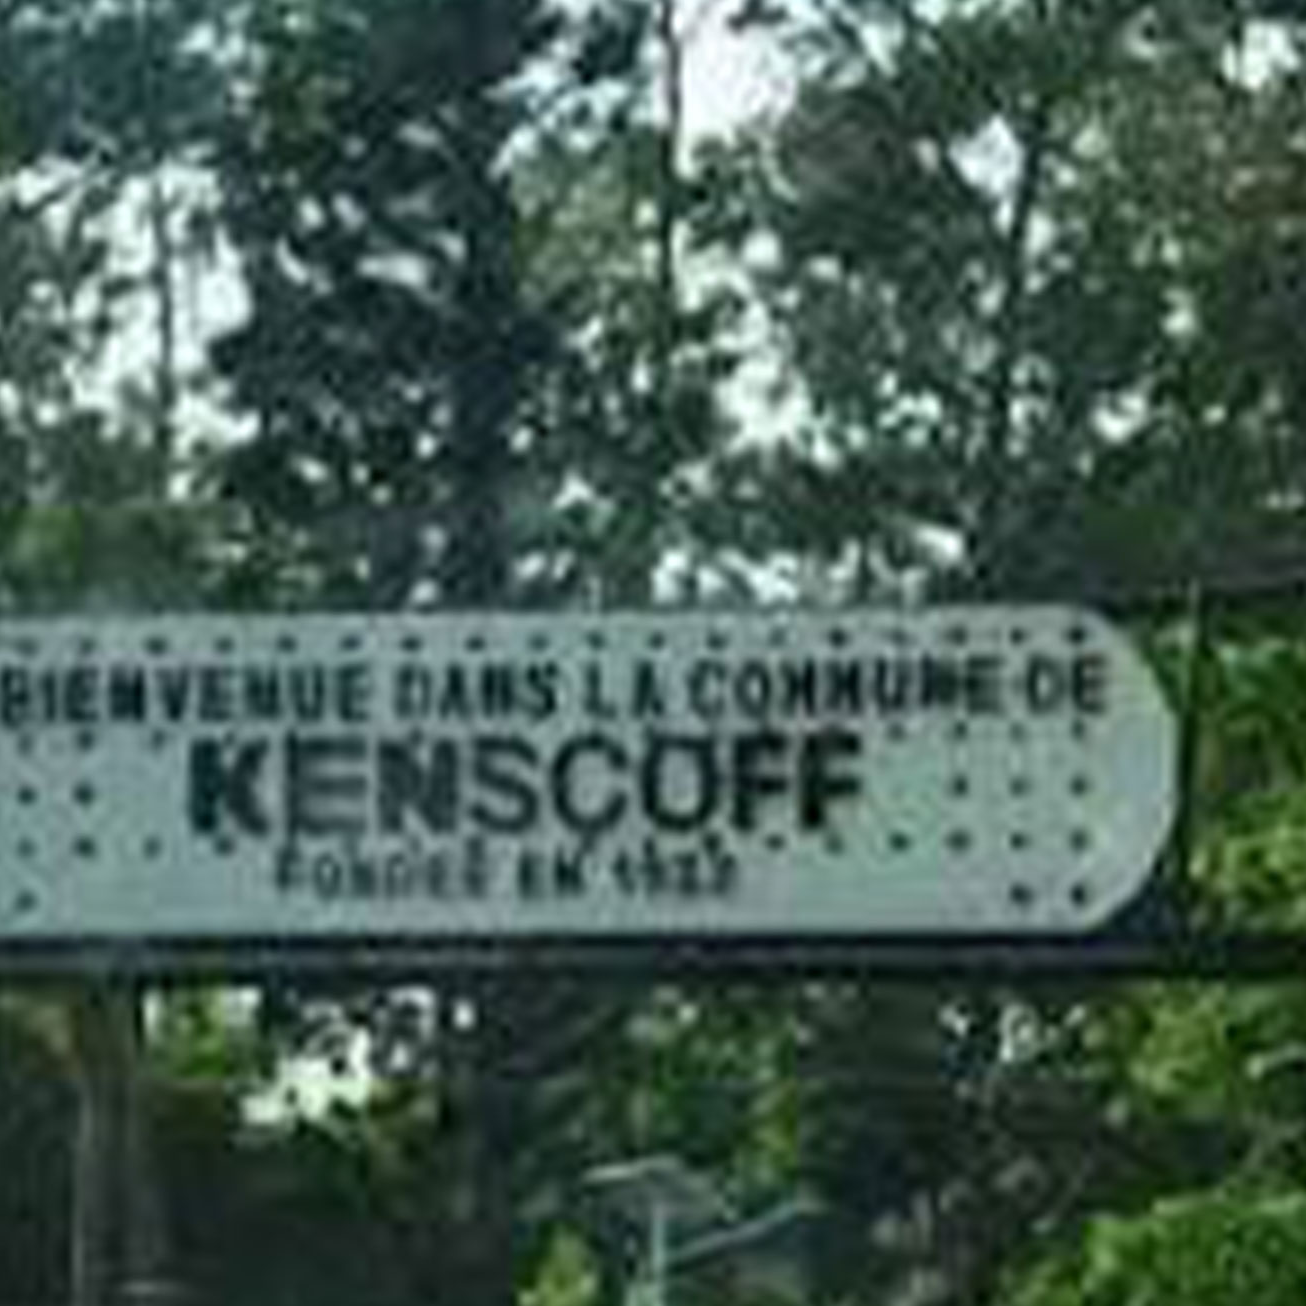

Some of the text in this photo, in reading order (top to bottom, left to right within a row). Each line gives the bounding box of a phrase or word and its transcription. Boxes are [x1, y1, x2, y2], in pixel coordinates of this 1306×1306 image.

[395, 660, 557, 722] DANS
[583, 656, 665, 720] LA
[688, 653, 1001, 719] COMMUNE
[1025, 653, 1107, 715] DE
[187, 729, 863, 838] KENSCOFF
